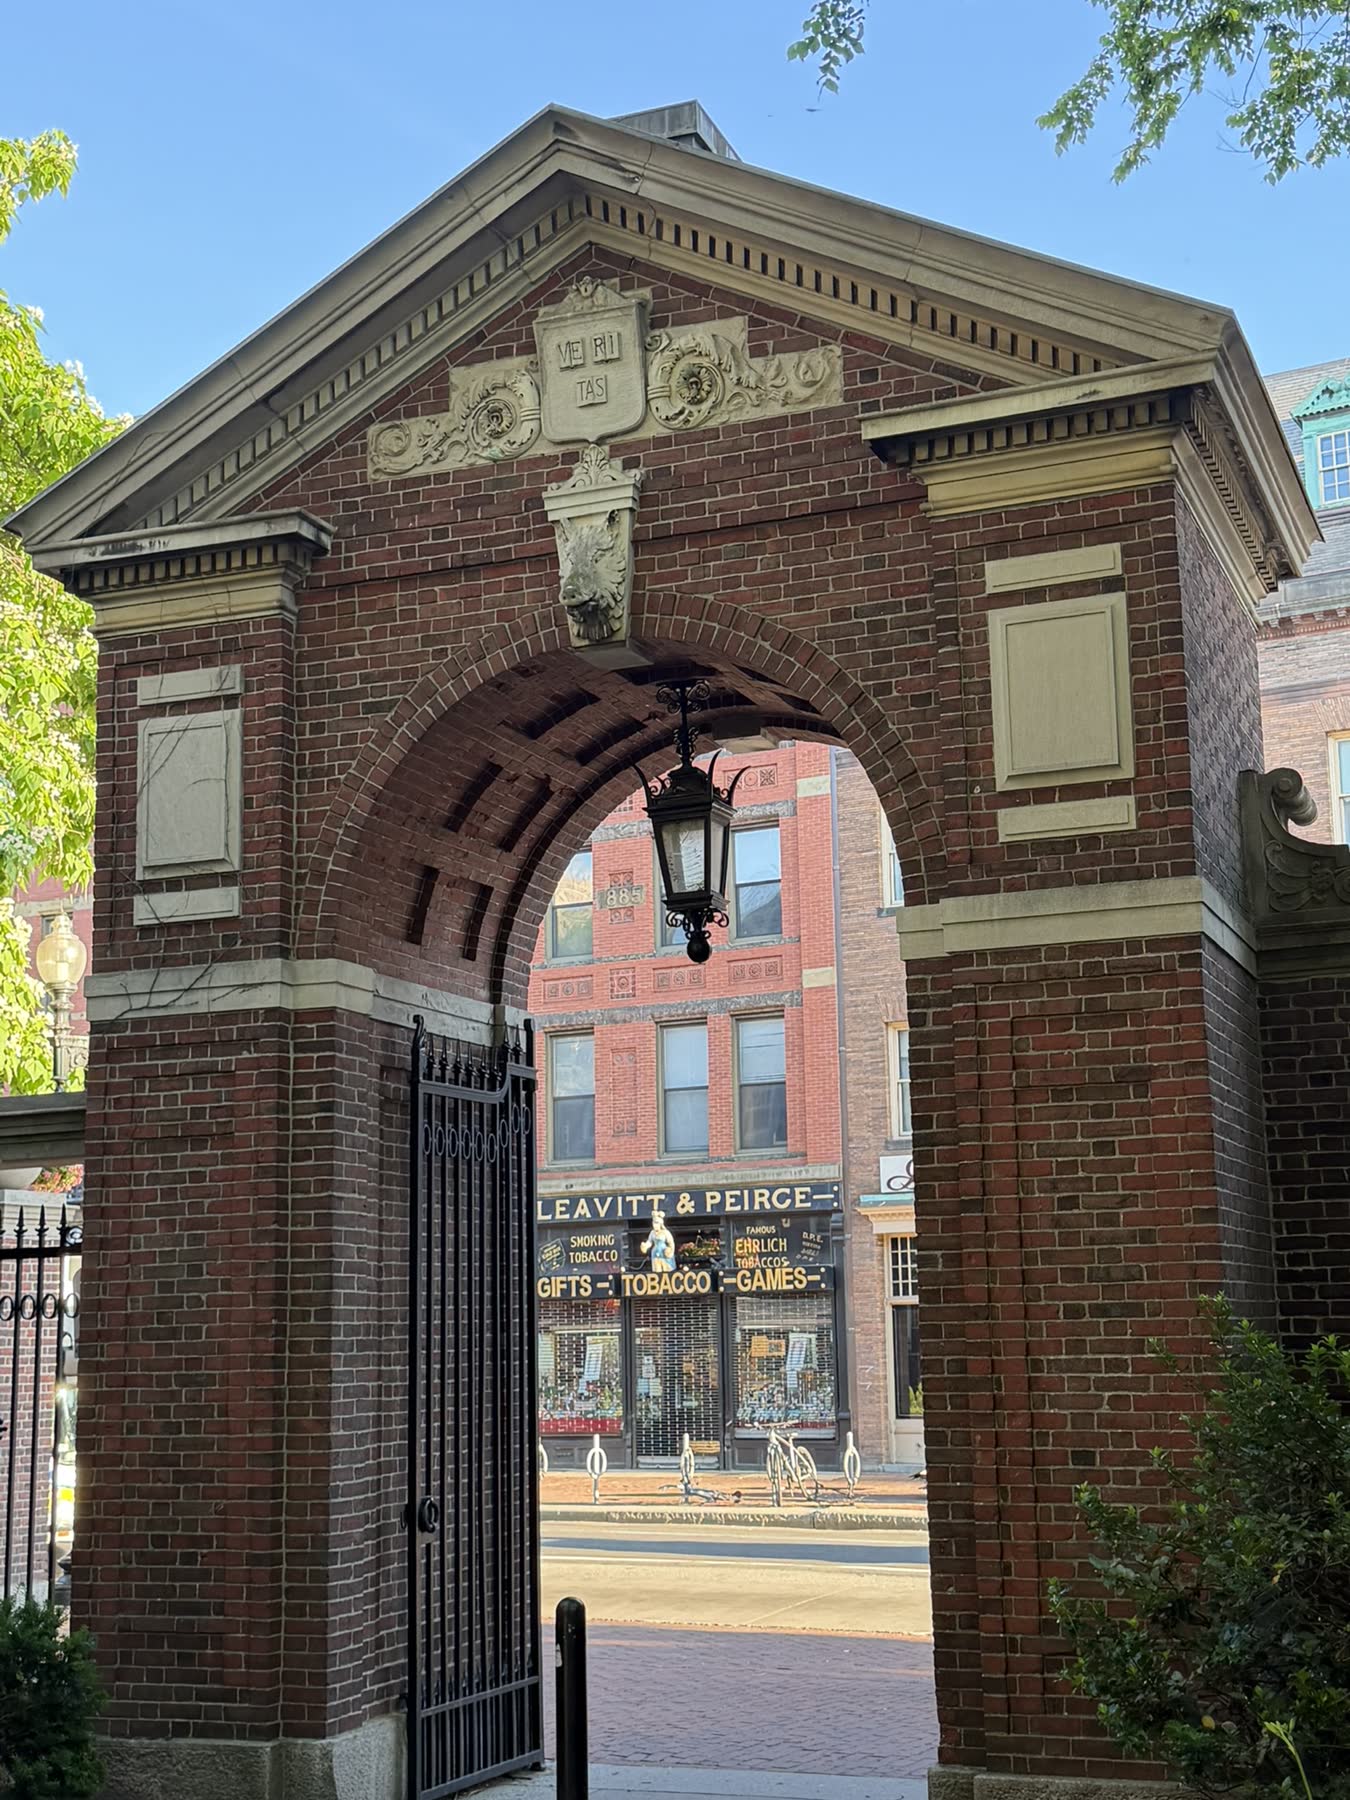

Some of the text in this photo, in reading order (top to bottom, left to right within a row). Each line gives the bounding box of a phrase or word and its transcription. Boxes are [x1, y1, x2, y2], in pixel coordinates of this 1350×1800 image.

[576, 377, 605, 401] TAS
[537, 1194, 665, 1220] LEAVITT
[676, 1192, 695, 1215] &
[746, 1226, 776, 1235] FAMOUS
[570, 1234, 615, 1248] SMOKING
[735, 1237, 787, 1254] EHRLICH
[569, 1250, 618, 1263] TOBACCO
[735, 1256, 789, 1269] TOBACCOS
[537, 1274, 592, 1298] GIFTS
[621, 1271, 711, 1297] TOBACCO
[736, 1267, 808, 1292] GAMES
